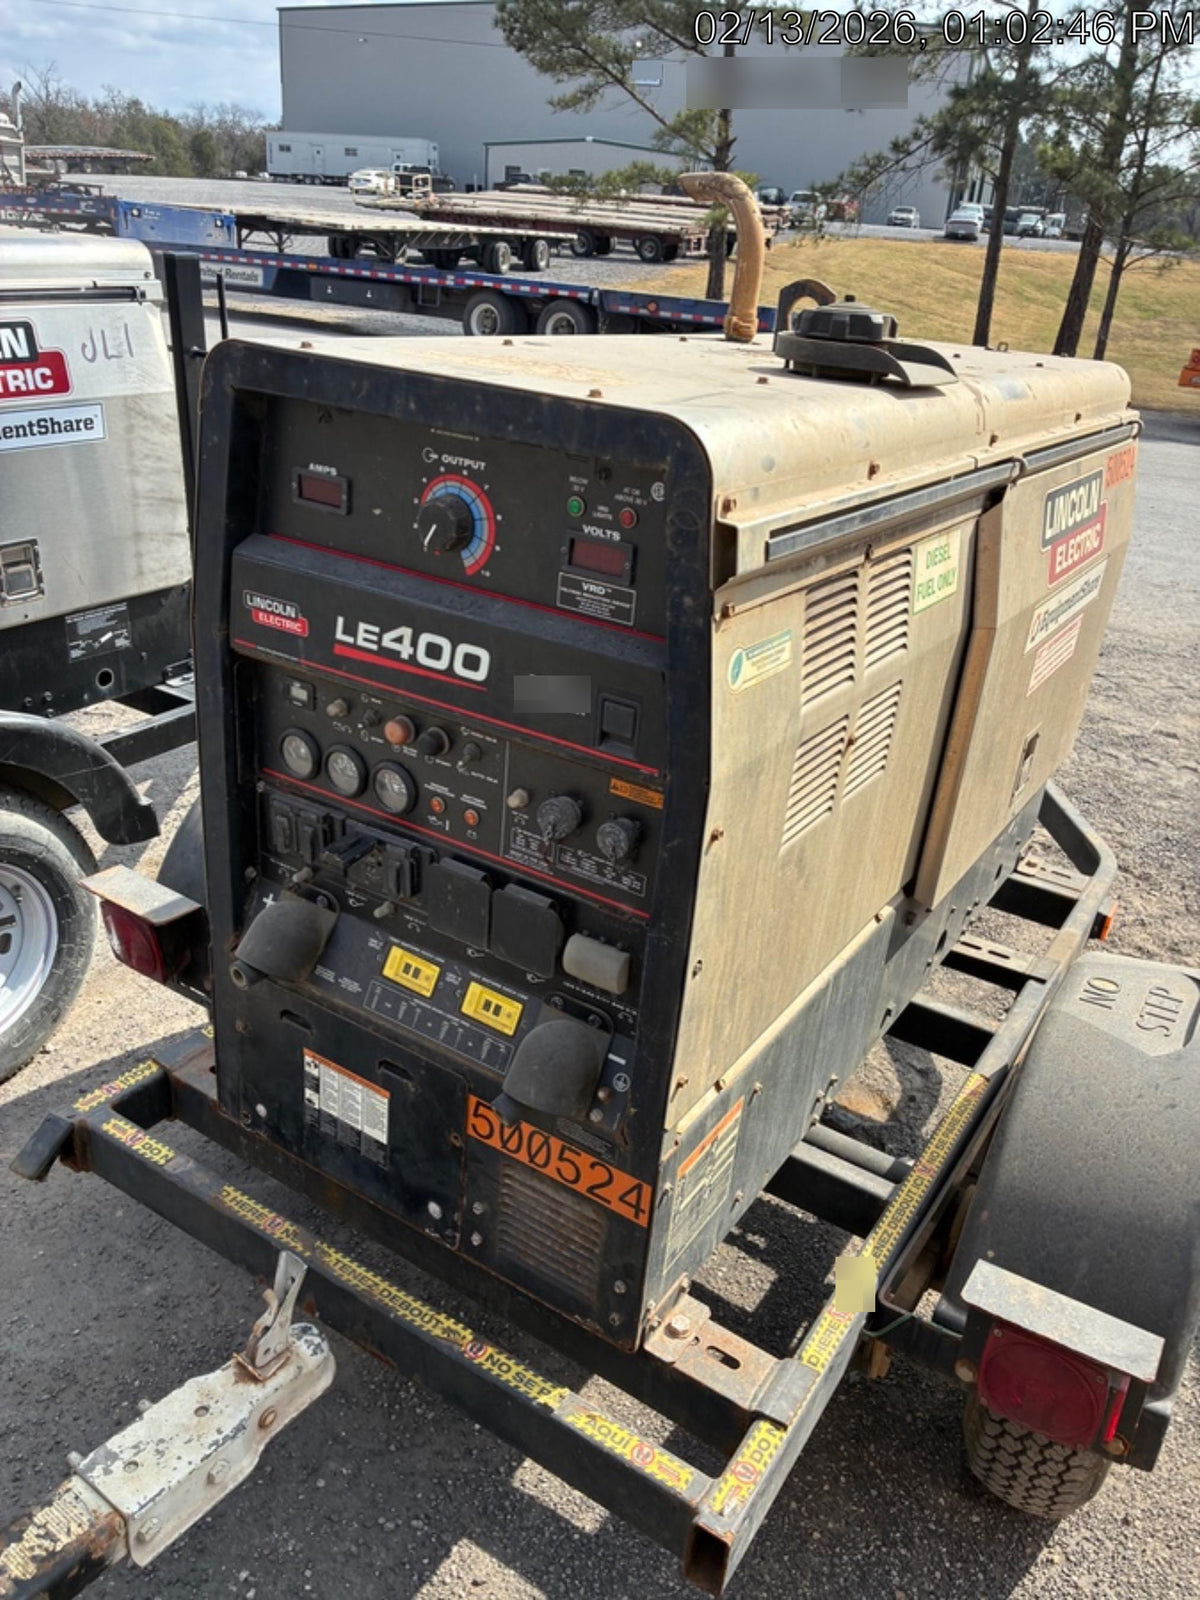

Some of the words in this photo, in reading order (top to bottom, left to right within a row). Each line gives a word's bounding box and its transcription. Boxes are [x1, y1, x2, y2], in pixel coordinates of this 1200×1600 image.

[0, 416, 95, 440] entShare
[308, 462, 338, 476] AMPS
[440, 453, 487, 471] OUTPUT
[1044, 477, 1101, 541] LINCOLN
[581, 524, 622, 542] VOLTS
[925, 543, 952, 571] DIESEL
[1055, 523, 1102, 575] ELECTRIC
[917, 577, 936, 602] FUEL
[936, 567, 957, 592] ONLY
[246, 594, 297, 618] LINCOLN
[257, 611, 304, 634] ELECTRIC
[334, 615, 492, 683] LE400
[1078, 976, 1121, 1010] NO
[1135, 985, 1184, 1038] STEP
[927, 1150, 941, 1165] NO
[231, 1195, 266, 1223] HERE
[872, 1224, 893, 1259] ENEZ
[888, 1190, 916, 1230] DEBOUT
[332, 1259, 379, 1292] TENEZ
[378, 1288, 444, 1330] DEBOUT
[486, 1351, 513, 1376] NO
[513, 1370, 538, 1392] SE
[751, 1436, 772, 1464] DO
